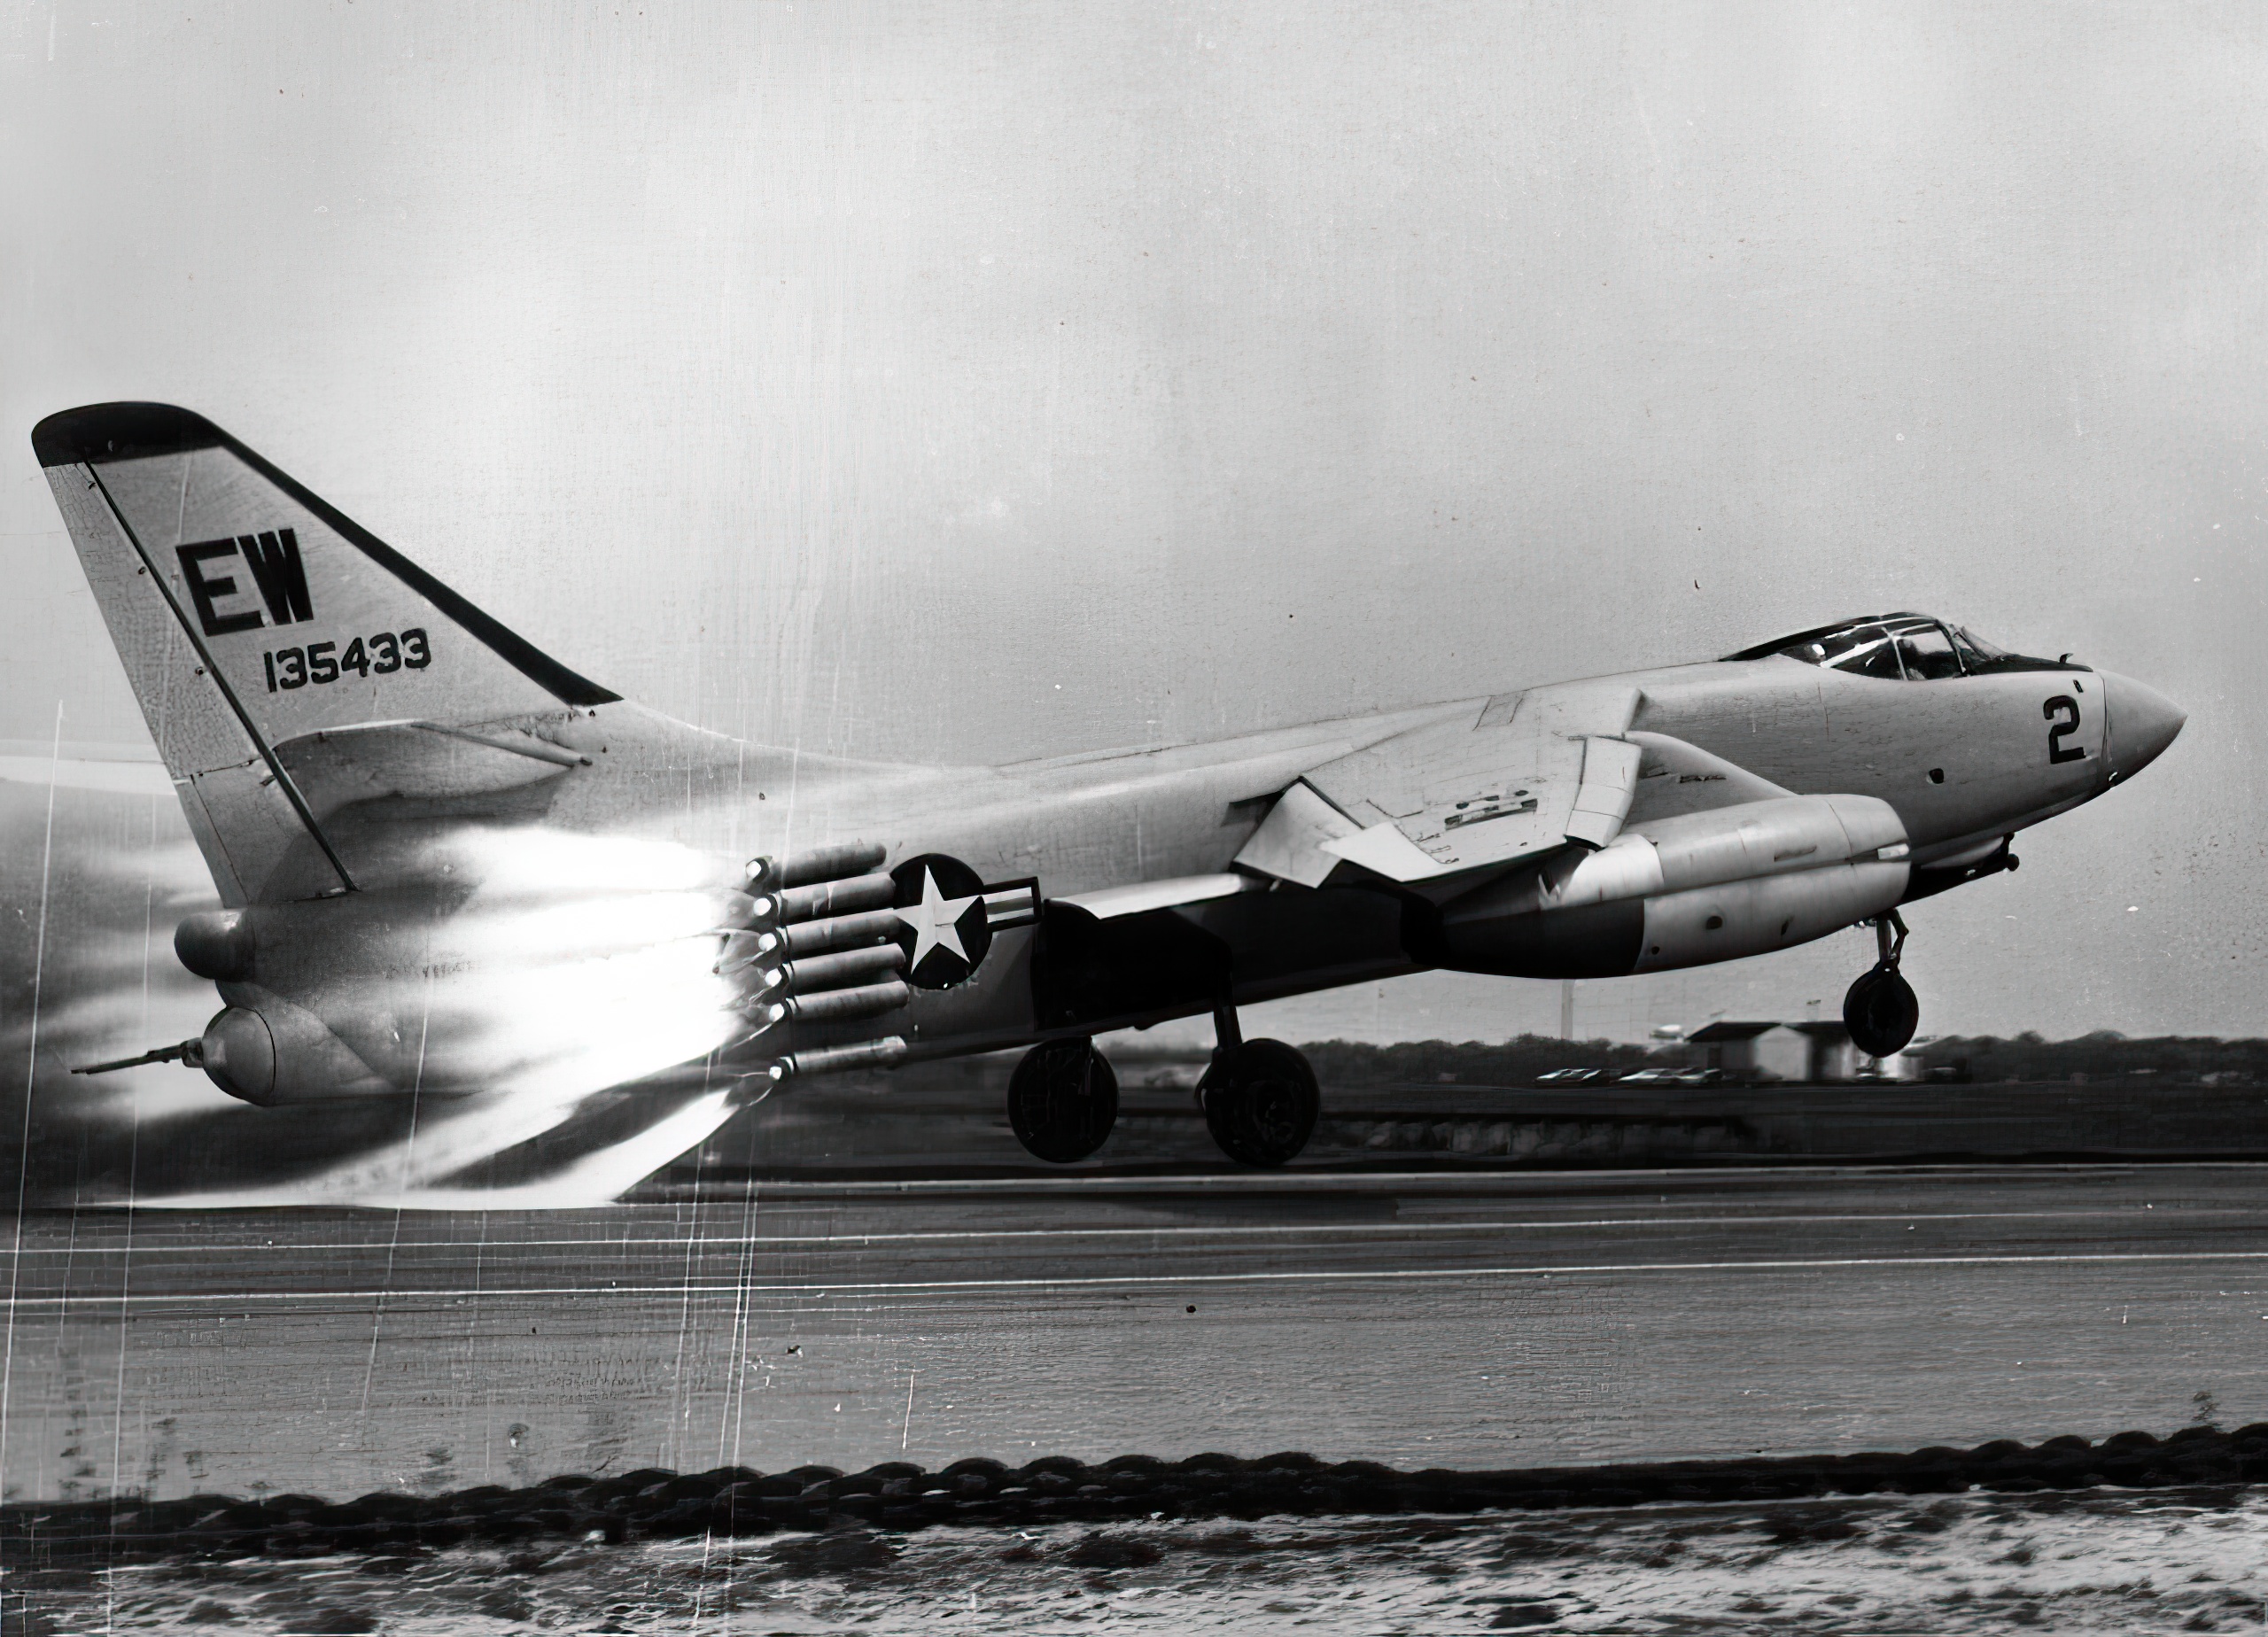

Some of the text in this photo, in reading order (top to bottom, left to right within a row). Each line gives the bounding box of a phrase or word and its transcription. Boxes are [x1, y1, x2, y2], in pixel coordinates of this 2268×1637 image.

[176, 528, 314, 636] EW
[264, 628, 431, 693] 135433
[2044, 695, 2086, 764] 2
